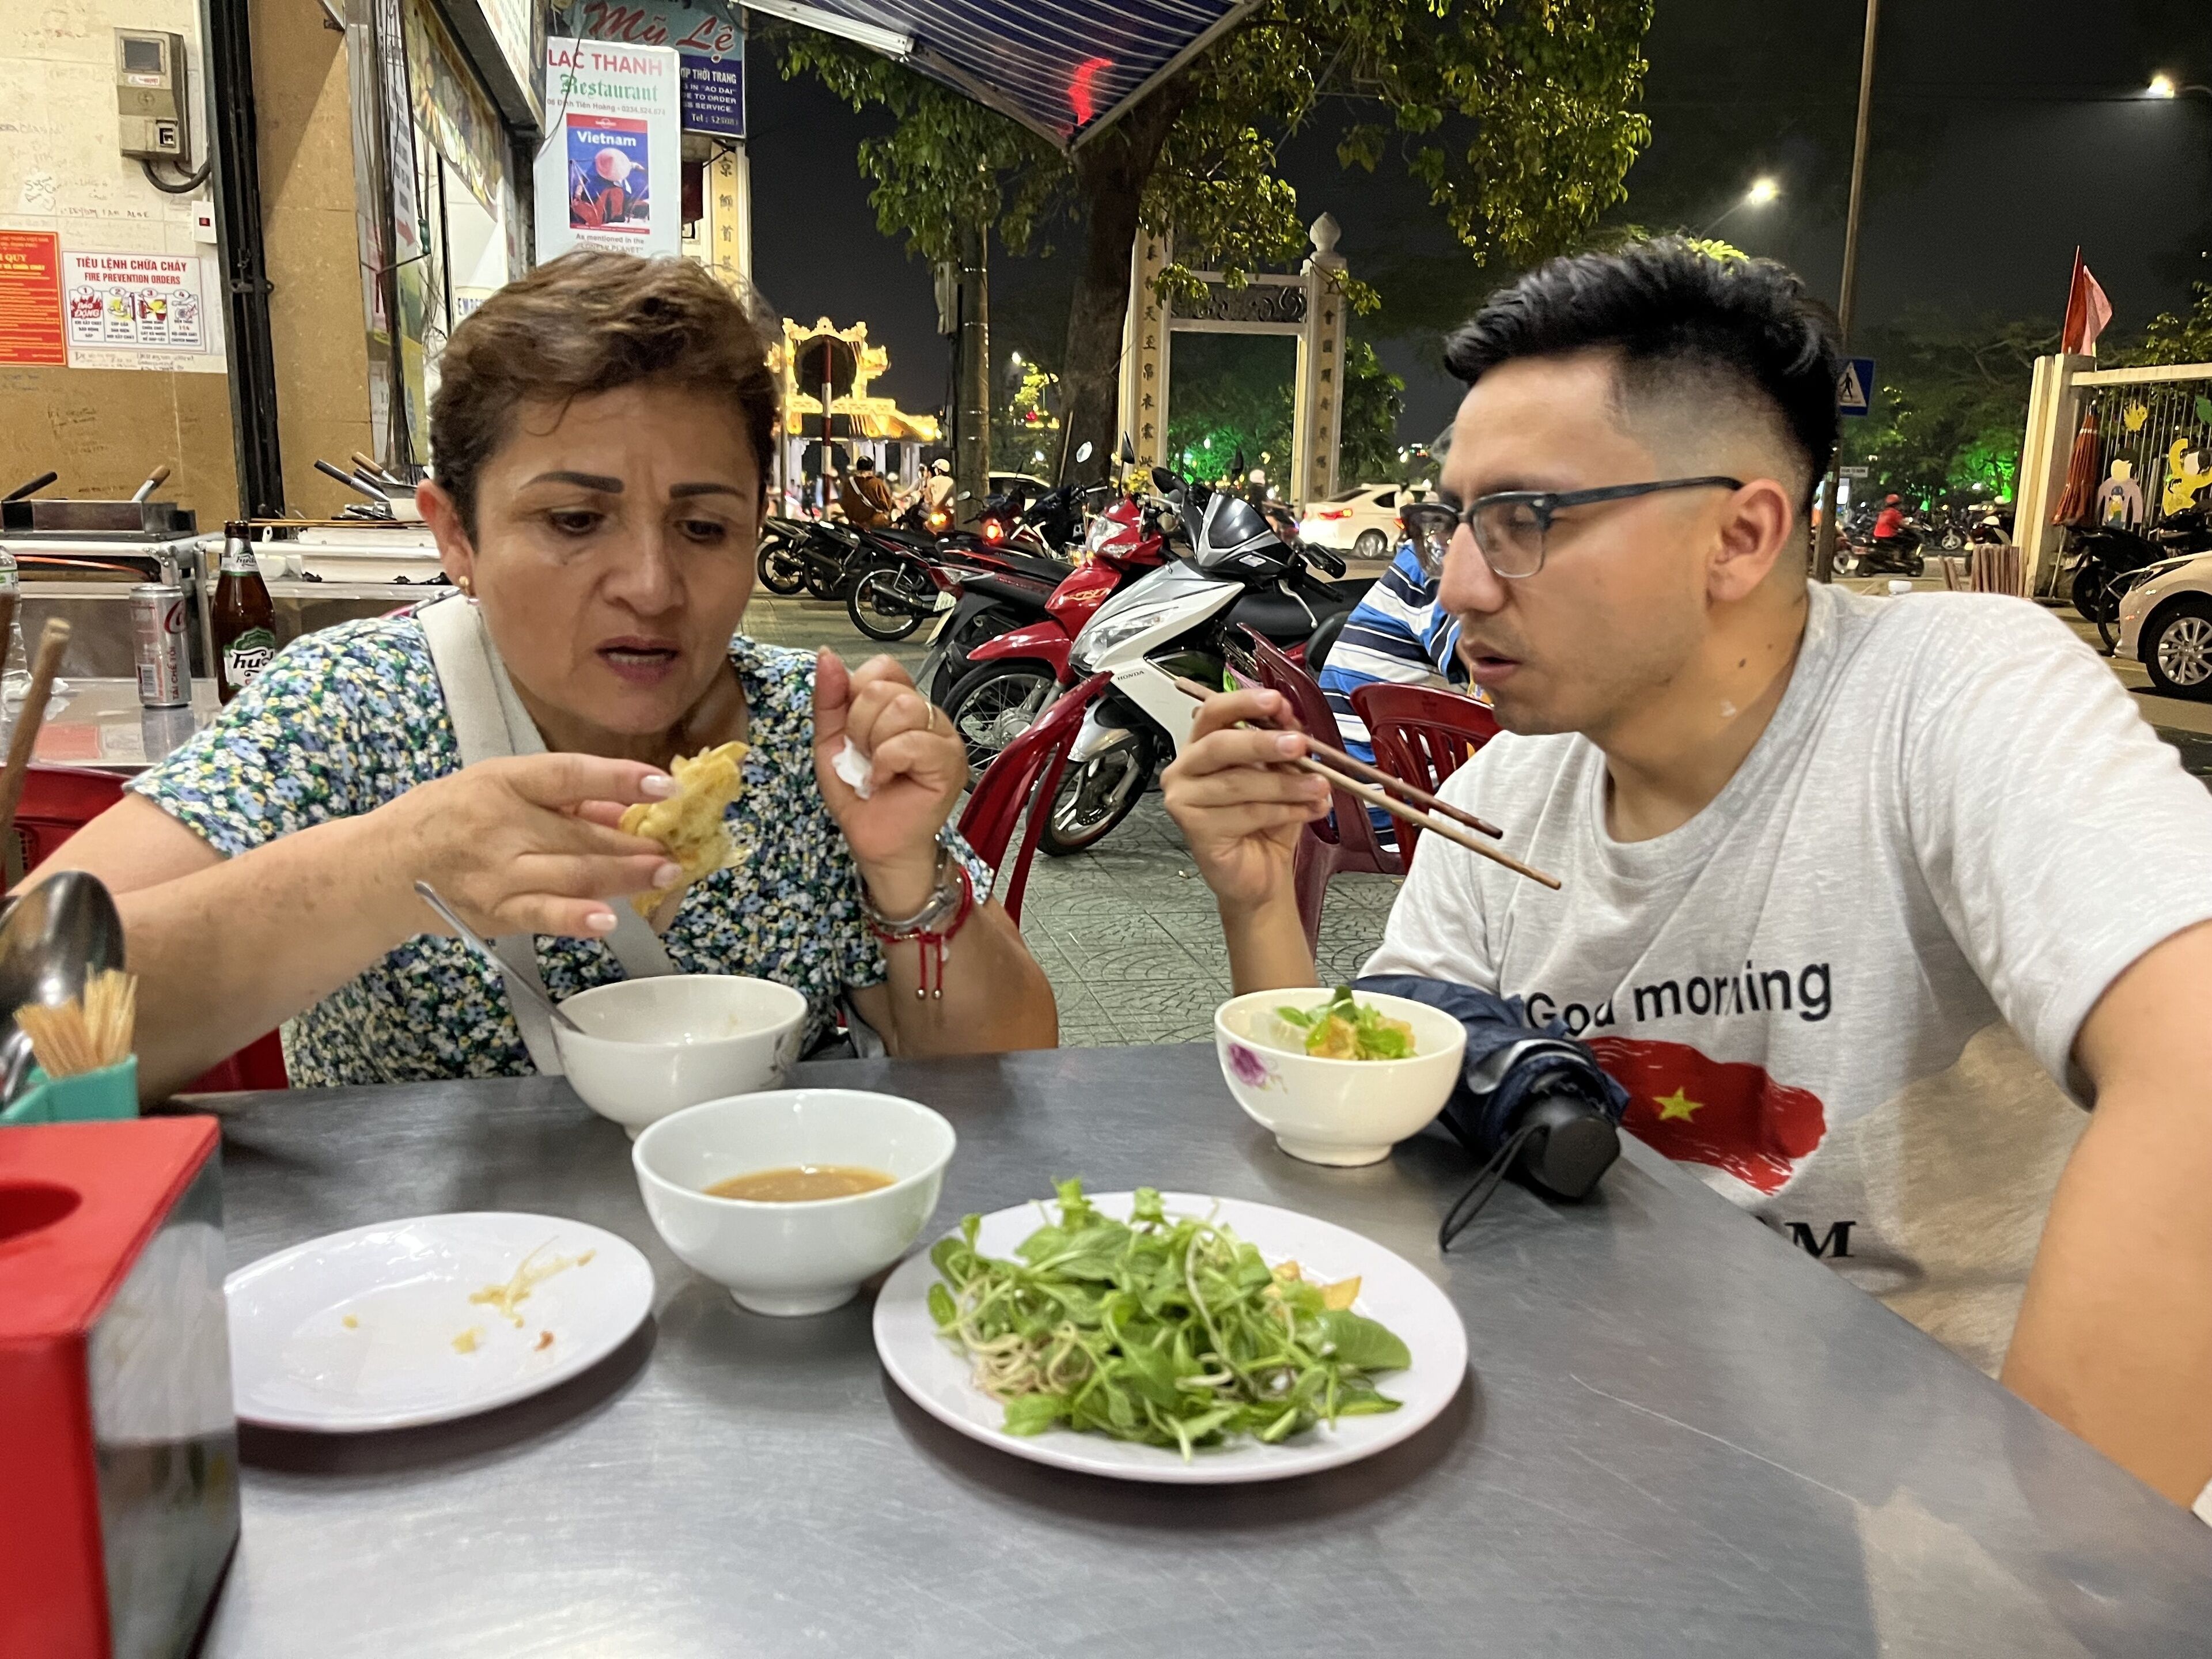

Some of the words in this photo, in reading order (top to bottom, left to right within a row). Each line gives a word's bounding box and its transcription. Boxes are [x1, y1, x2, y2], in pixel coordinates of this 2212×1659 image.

[711, 70, 737, 84] TRANG
[560, 73, 658, 102] Restaurant
[707, 95, 736, 104] ORDER
[577, 131, 637, 147] Vietnam
[587, 234, 623, 243] mentioned
[76, 256, 98, 268] TIÊU
[101, 257, 127, 271] LỆNH
[85, 272, 100, 282] FIRE
[103, 273, 149, 283] PREVENTION
[151, 275, 180, 285] ORDERS
[1118, 671, 1145, 680] HONDA
